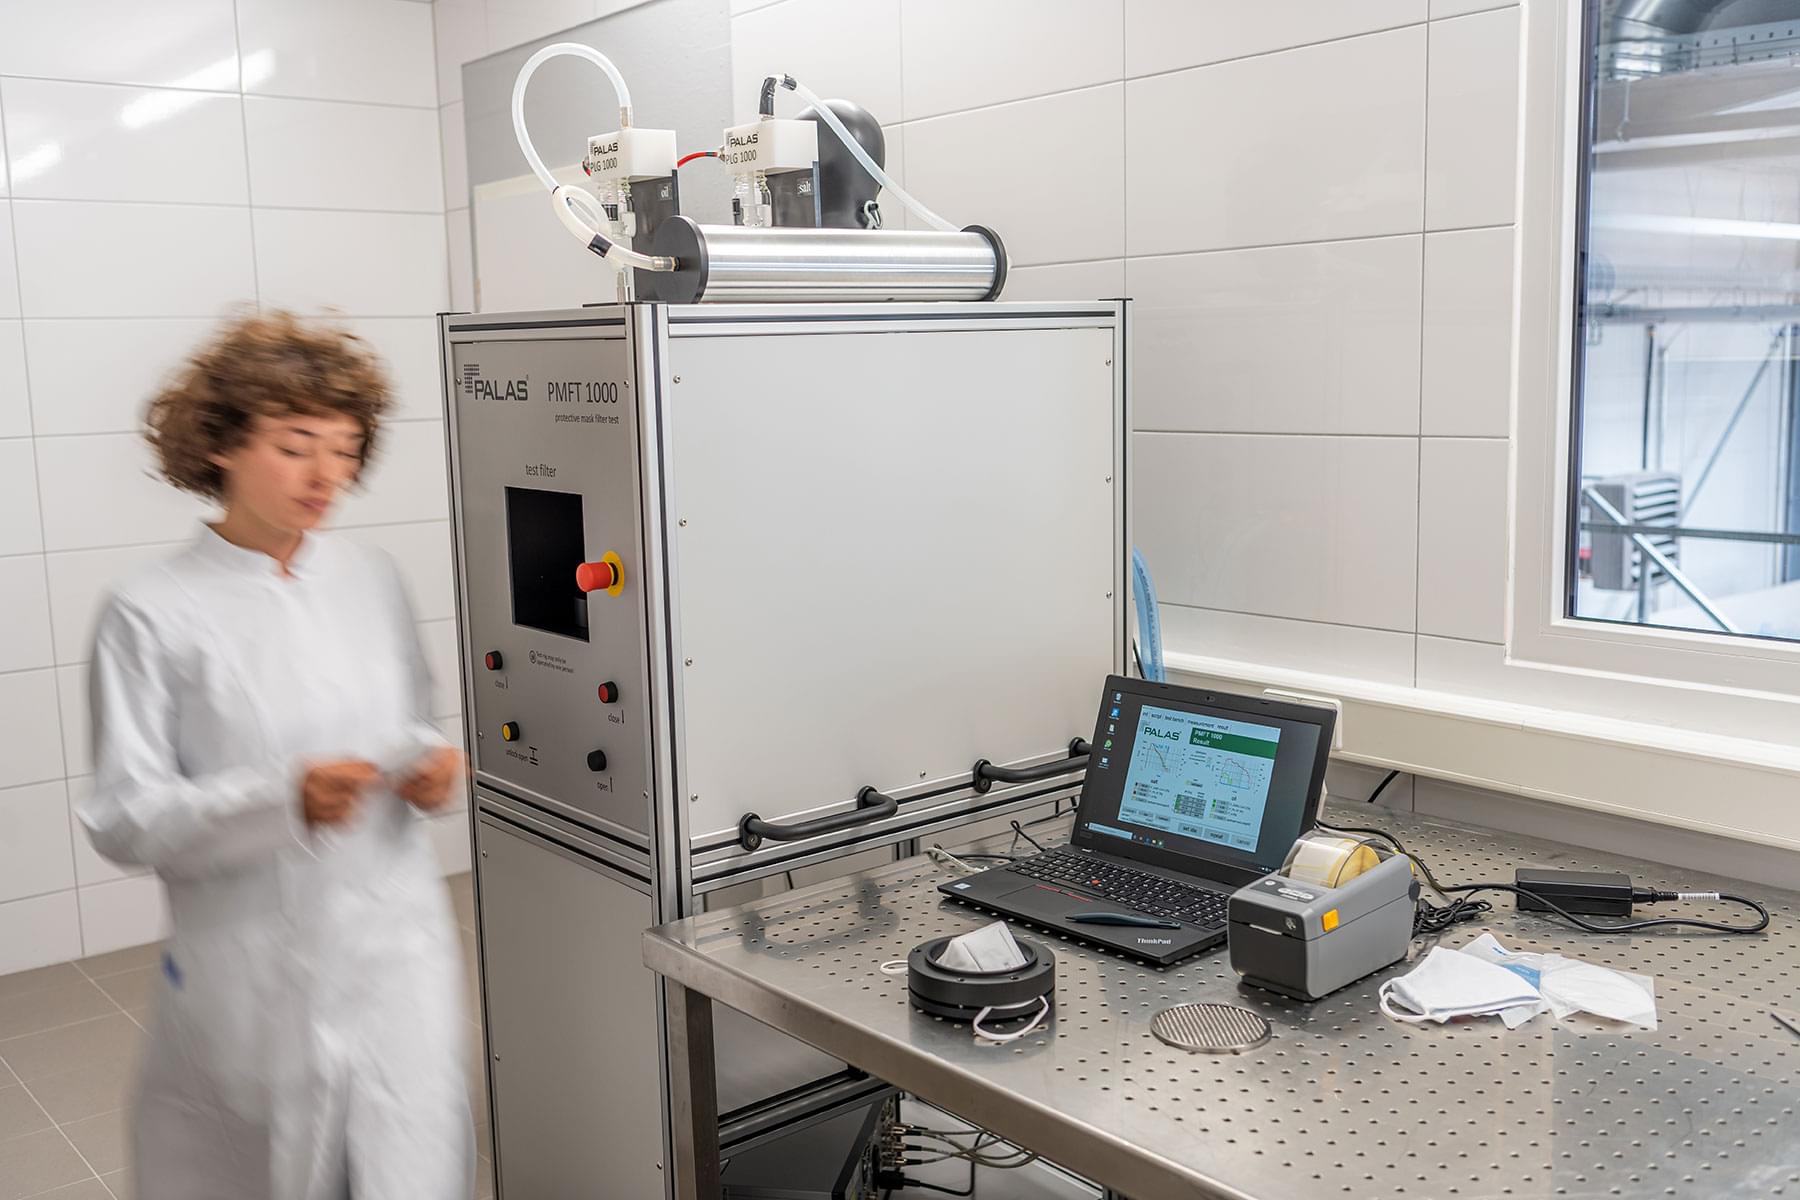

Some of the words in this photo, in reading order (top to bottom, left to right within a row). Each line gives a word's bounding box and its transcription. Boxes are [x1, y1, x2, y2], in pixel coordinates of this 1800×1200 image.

[730, 133, 759, 148] PALAS
[593, 142, 619, 157] PALAS
[603, 157, 618, 171] 1000
[725, 153, 738, 165] PLG
[740, 149, 757, 163] 1000
[660, 186, 669, 198] oil
[799, 180, 812, 193] salt
[474, 379, 529, 401] PALAS
[548, 382, 582, 403] PMFT
[585, 382, 618, 404] 1000
[555, 414, 581, 424] protective
[581, 413, 594, 423] mask
[594, 414, 608, 424] filter
[608, 415, 620, 425] test
[525, 463, 539, 477] test
[540, 464, 557, 478] filter
[607, 712, 620, 724] close
[1143, 726, 1180, 741] PALAS
[1193, 737, 1210, 746] Result
[1137, 937, 1172, 945] ThinkPad
